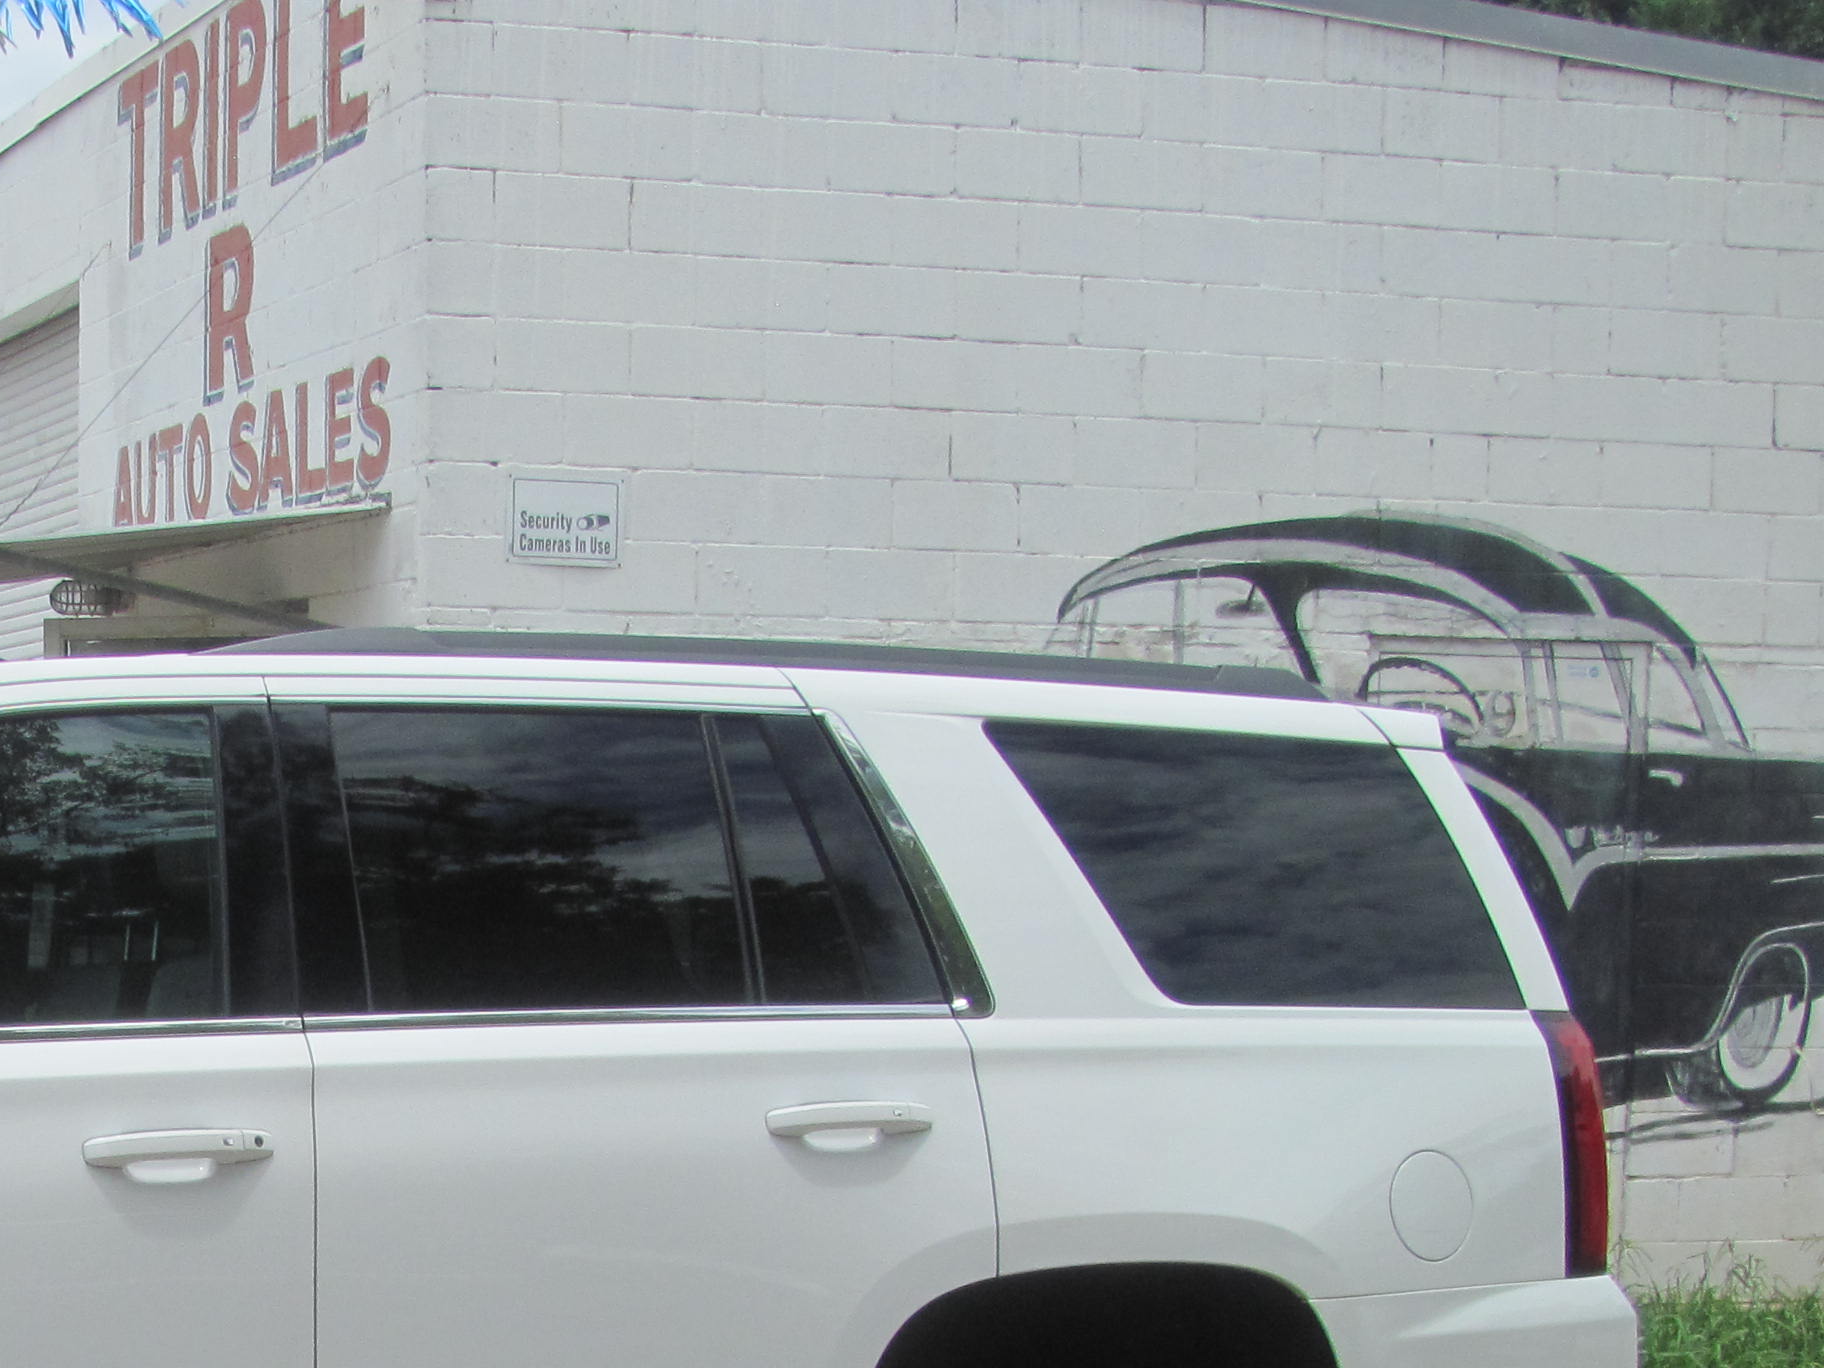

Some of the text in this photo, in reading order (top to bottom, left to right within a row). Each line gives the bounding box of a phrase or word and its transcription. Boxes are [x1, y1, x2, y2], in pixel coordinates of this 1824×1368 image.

[118, 0, 369, 260] TRIPLE
[203, 222, 255, 407] R
[114, 355, 391, 527] AUTO SALES
[520, 510, 573, 533] Security
[519, 533, 611, 555] Cameras In Use
